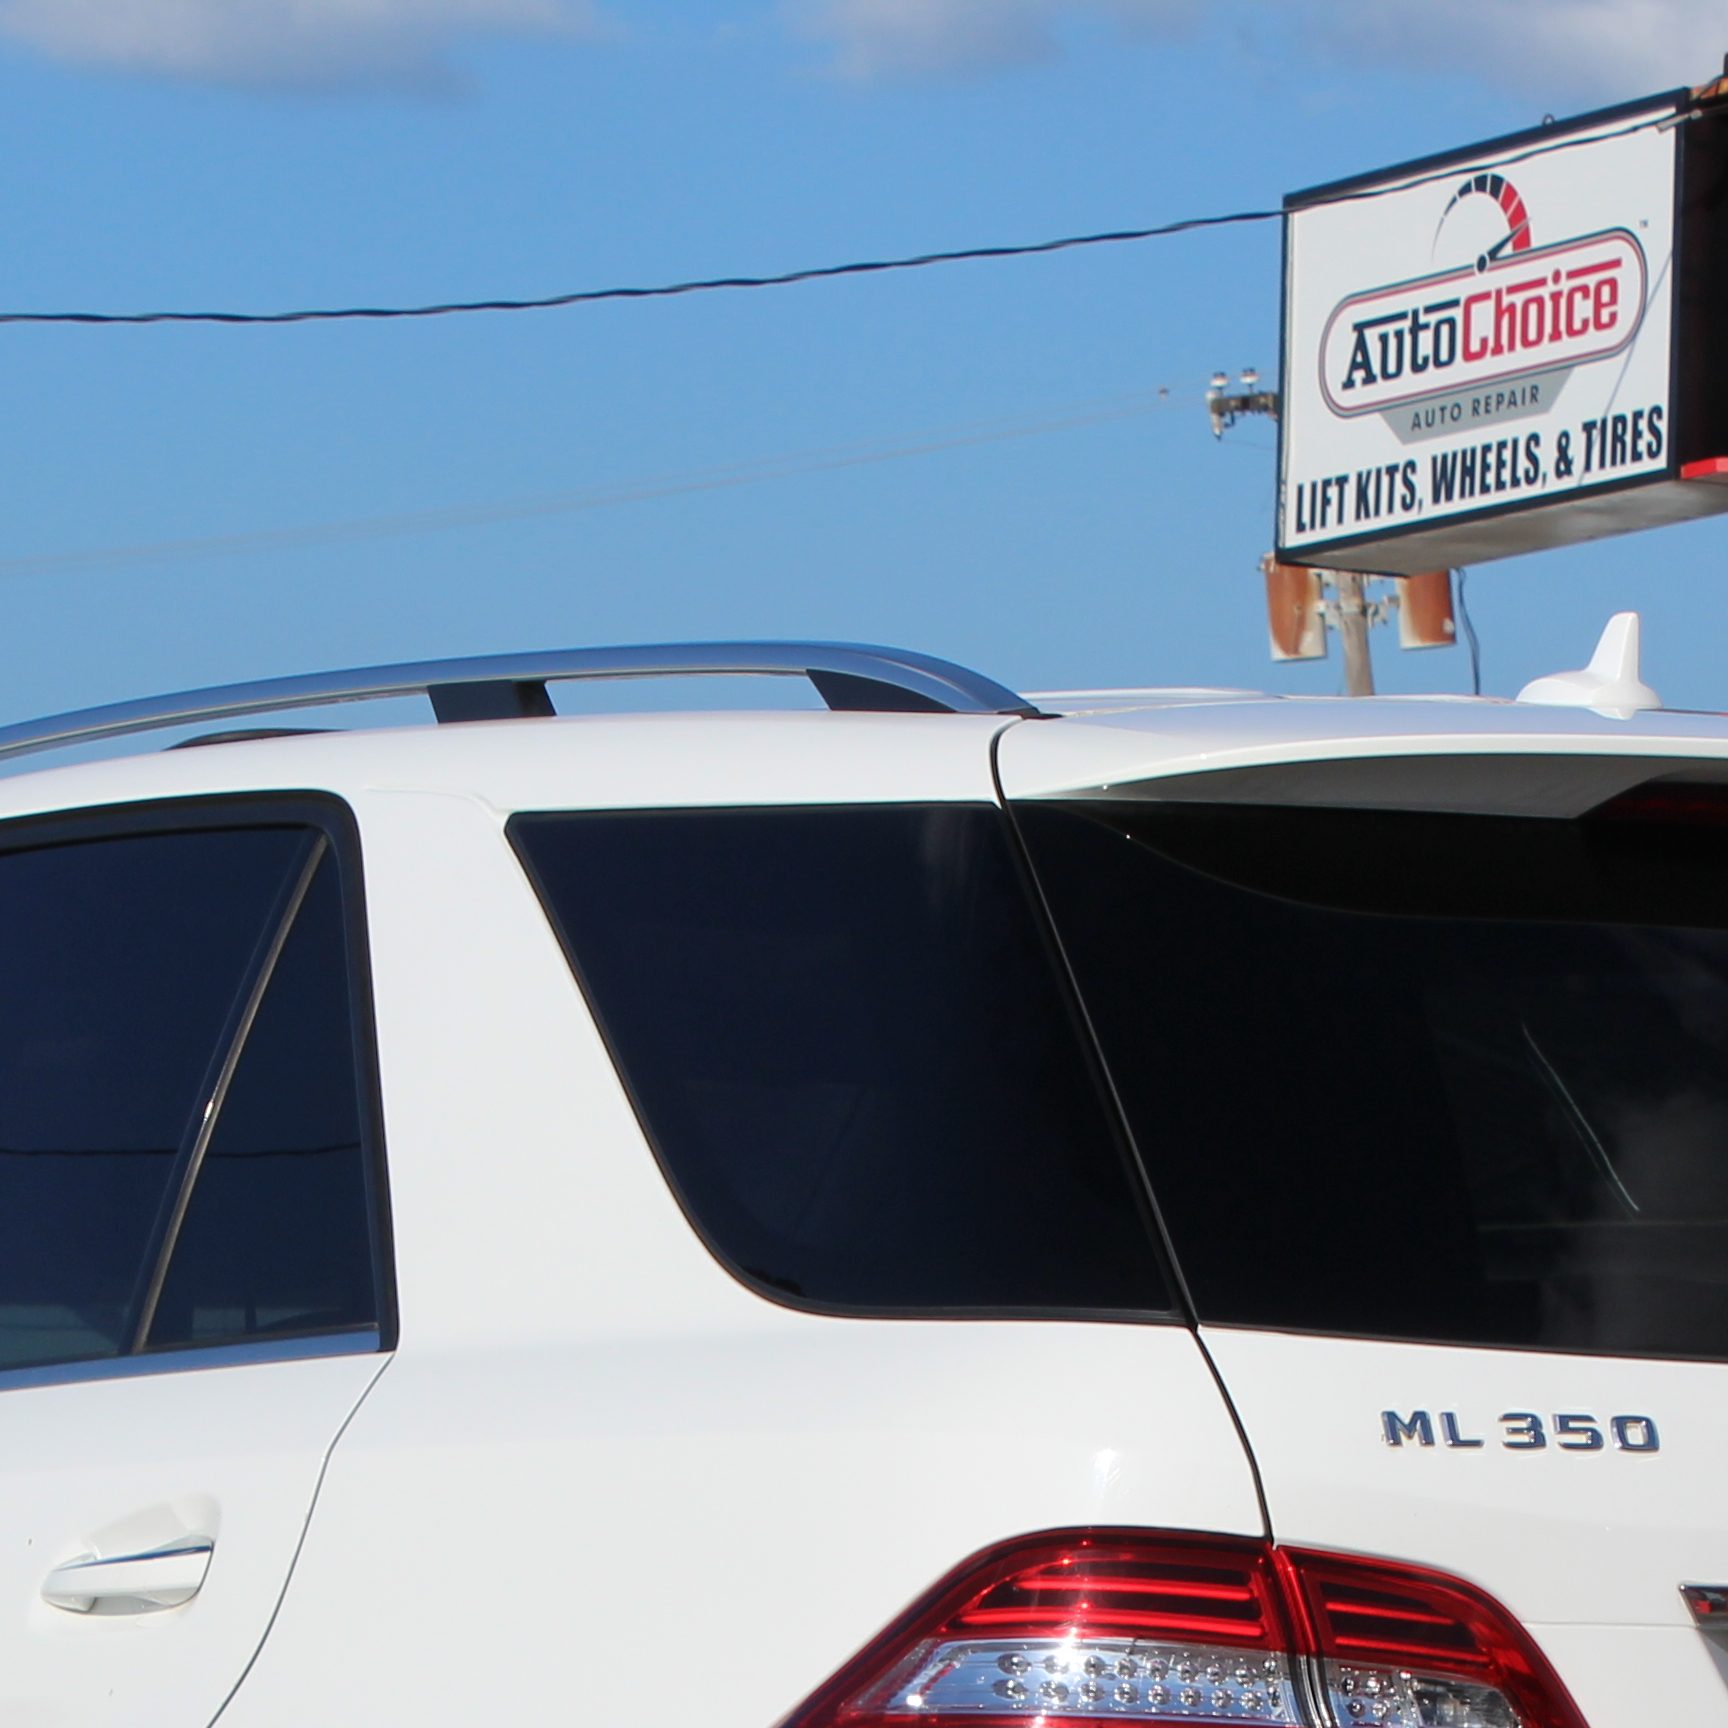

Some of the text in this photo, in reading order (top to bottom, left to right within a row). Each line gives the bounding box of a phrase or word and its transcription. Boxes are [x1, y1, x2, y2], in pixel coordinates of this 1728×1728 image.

[1341, 256, 1622, 391] AutoChoice
[1410, 384, 1540, 431] AUTO REPAIR
[1295, 404, 1664, 534] LIFT KITS, WHEELS, & TIRES
[1381, 1409, 1661, 1453] ML 350
